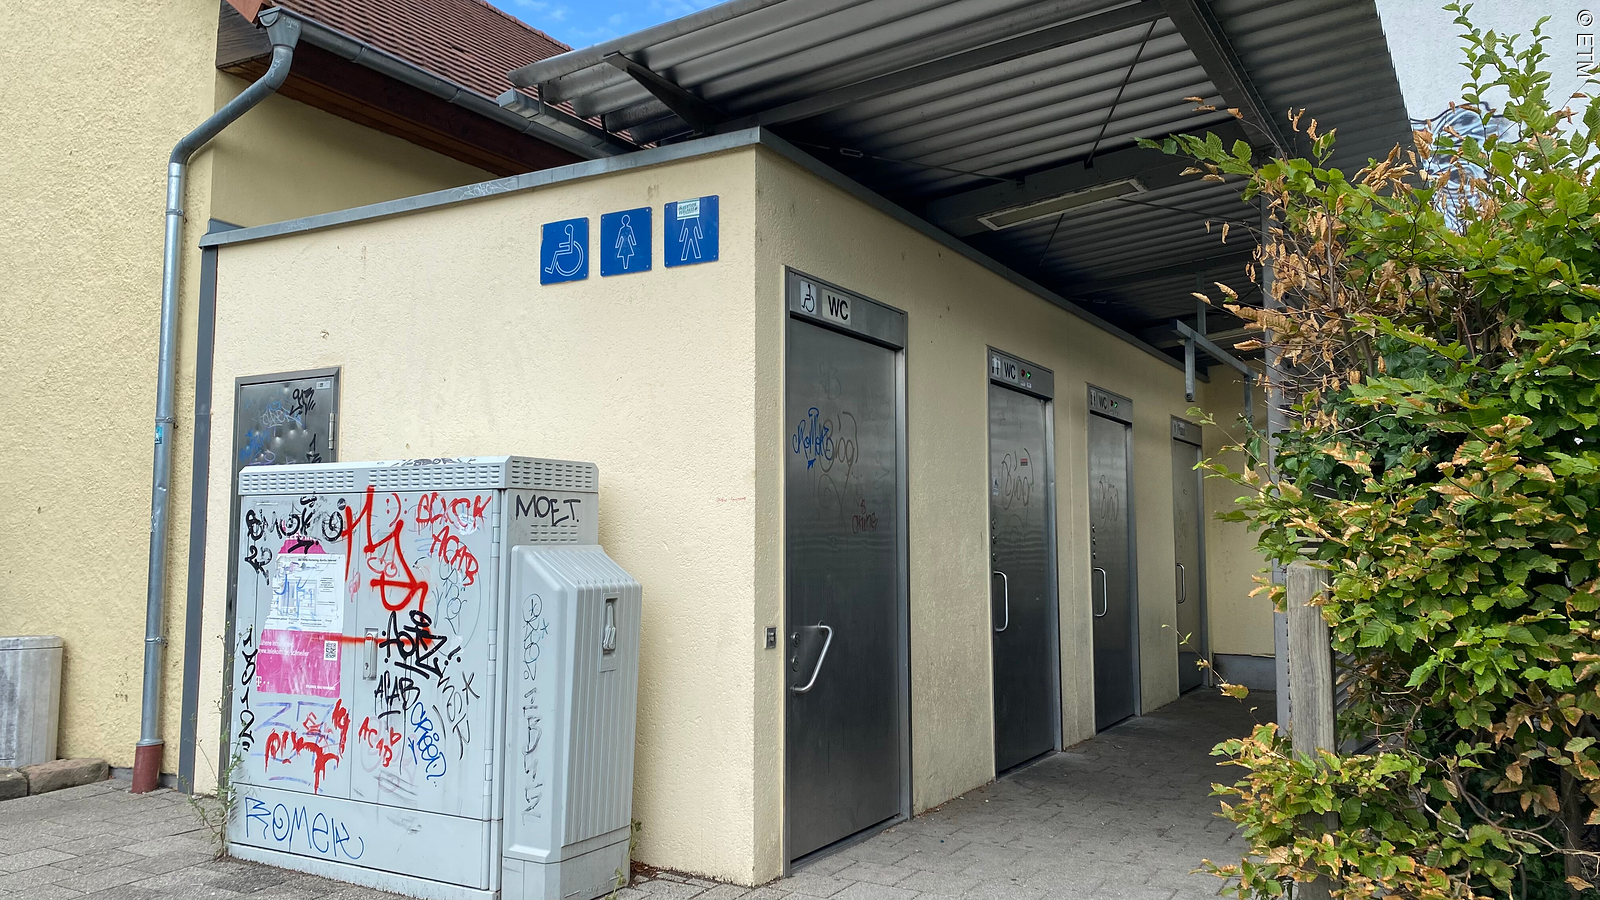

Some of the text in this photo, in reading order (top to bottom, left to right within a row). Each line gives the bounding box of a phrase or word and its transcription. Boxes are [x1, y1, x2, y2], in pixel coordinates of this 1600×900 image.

[827, 294, 849, 321] WC
[1003, 361, 1016, 380] WC
[1098, 394, 1108, 410] WC
[373, 670, 421, 711] ACAB
